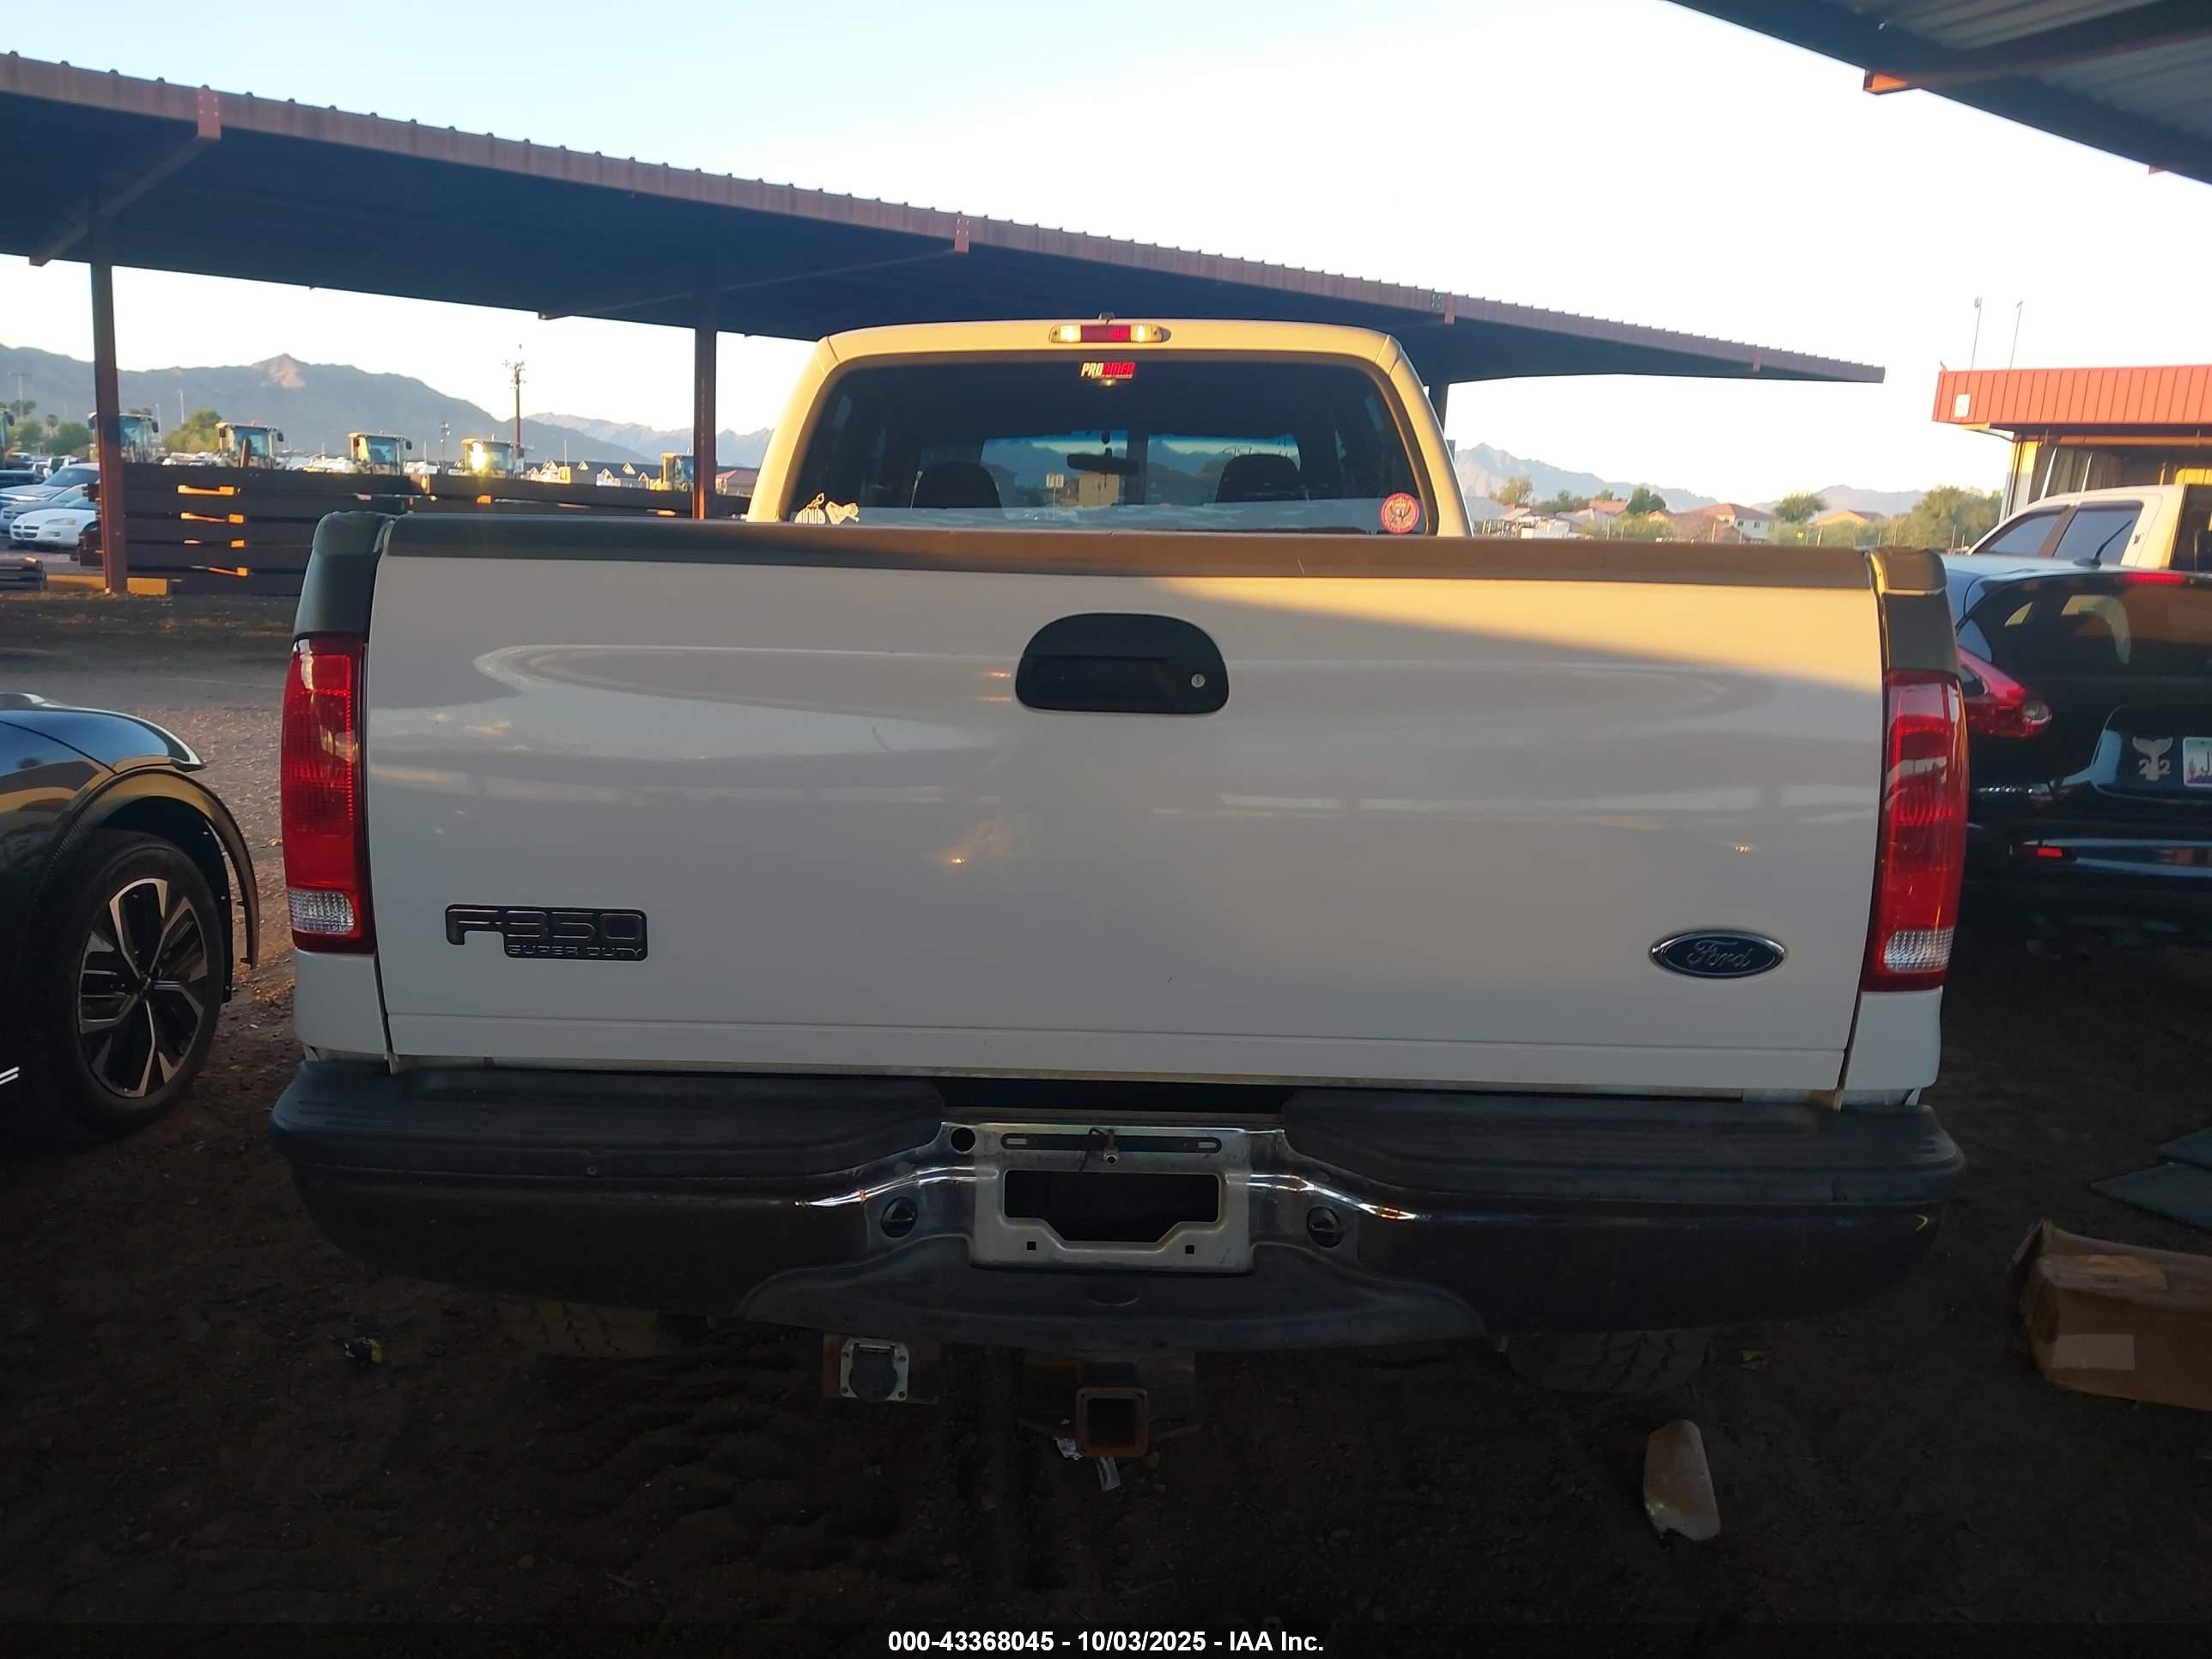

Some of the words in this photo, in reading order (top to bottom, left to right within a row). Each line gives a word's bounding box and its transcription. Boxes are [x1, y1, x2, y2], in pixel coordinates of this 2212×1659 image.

[446, 907, 645, 945] F-350
[507, 945, 579, 956] SUPER
[585, 946, 643, 957] DUTY
[1686, 939, 1753, 969] Ford
